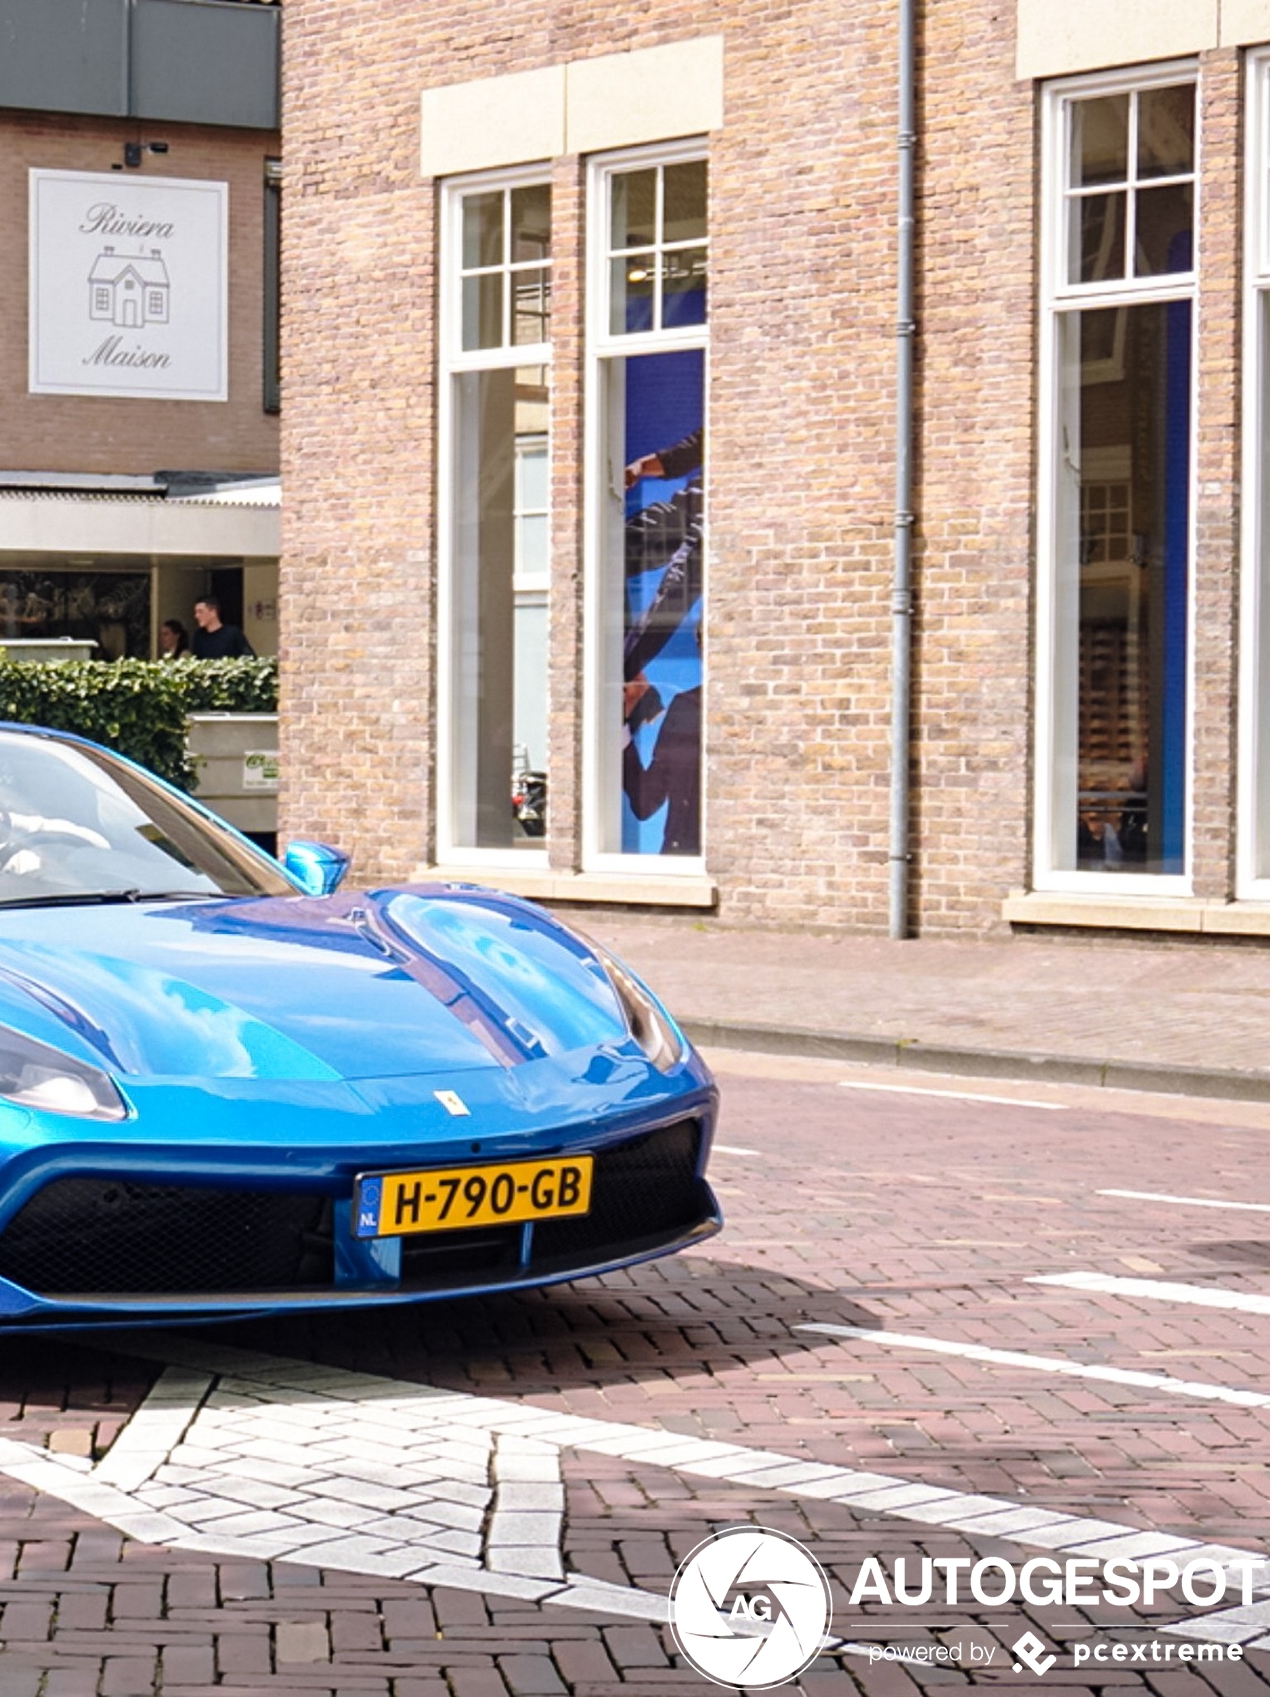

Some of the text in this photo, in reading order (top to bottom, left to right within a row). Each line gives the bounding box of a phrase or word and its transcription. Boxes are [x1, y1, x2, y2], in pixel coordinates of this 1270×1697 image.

[79, 202, 174, 239] Riviera
[81, 334, 171, 369] Maison
[394, 1166, 582, 1226] H-790-GB
[360, 1212, 377, 1226] NL
